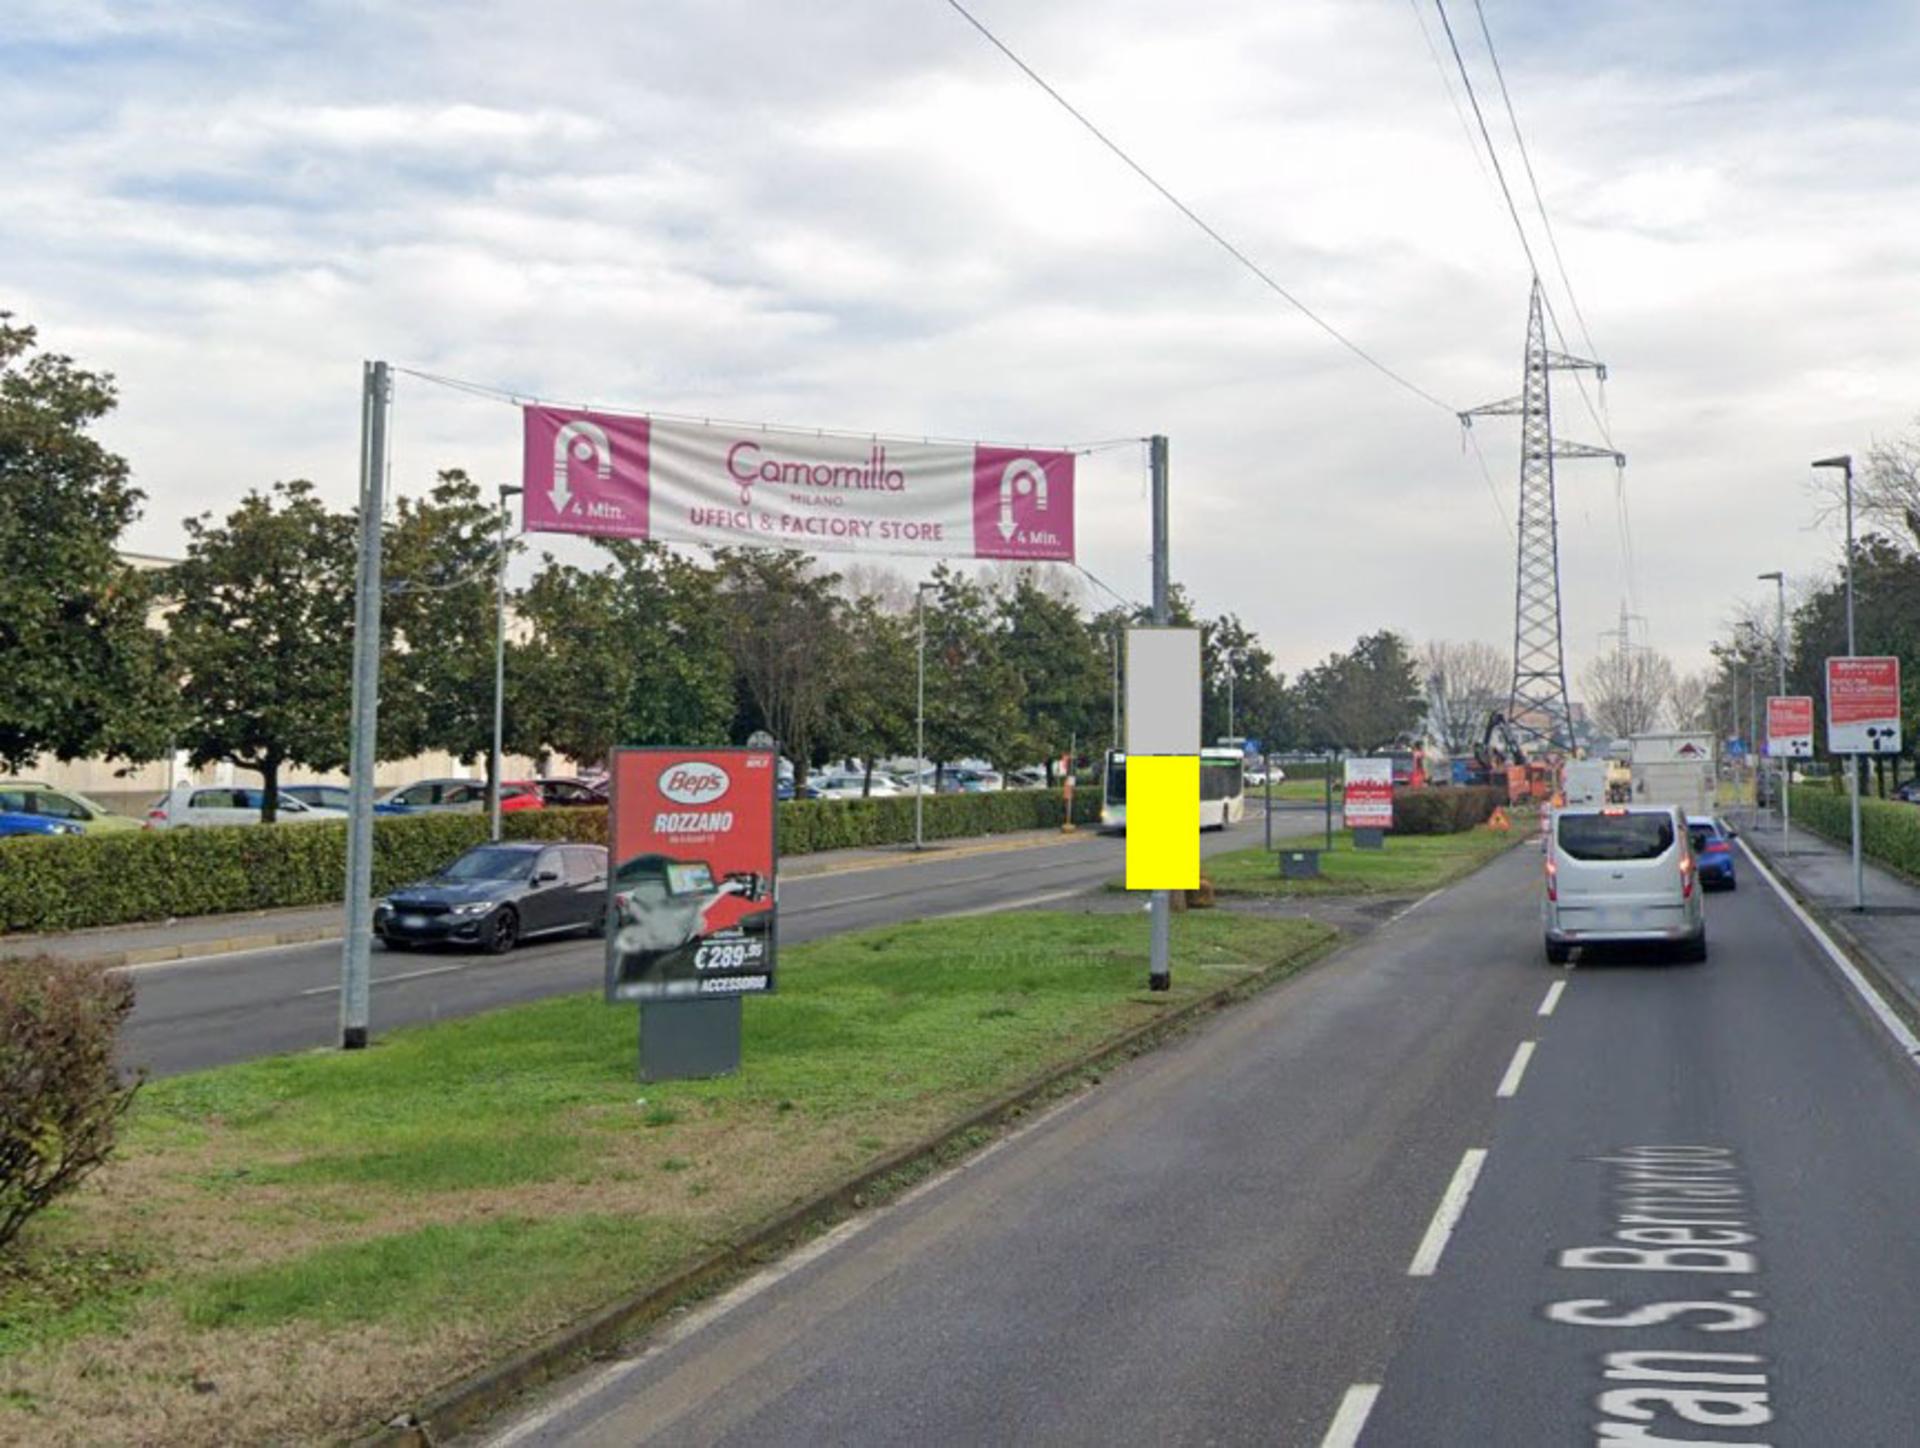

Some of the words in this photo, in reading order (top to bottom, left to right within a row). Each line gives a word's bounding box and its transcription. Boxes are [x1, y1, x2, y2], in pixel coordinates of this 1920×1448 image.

[726, 440, 905, 492] Camomilla
[571, 502, 583, 516] 4
[587, 502, 627, 520] Min.
[790, 494, 844, 507] MILANO
[690, 508, 752, 529] UFFICI
[759, 512, 774, 530] &
[780, 514, 872, 537] FACTORY
[880, 522, 943, 541] STORE
[1017, 531, 1027, 544] 4
[1029, 532, 1061, 546] Min.
[667, 771, 722, 796] Bep's
[654, 811, 734, 833] ROZZANO
